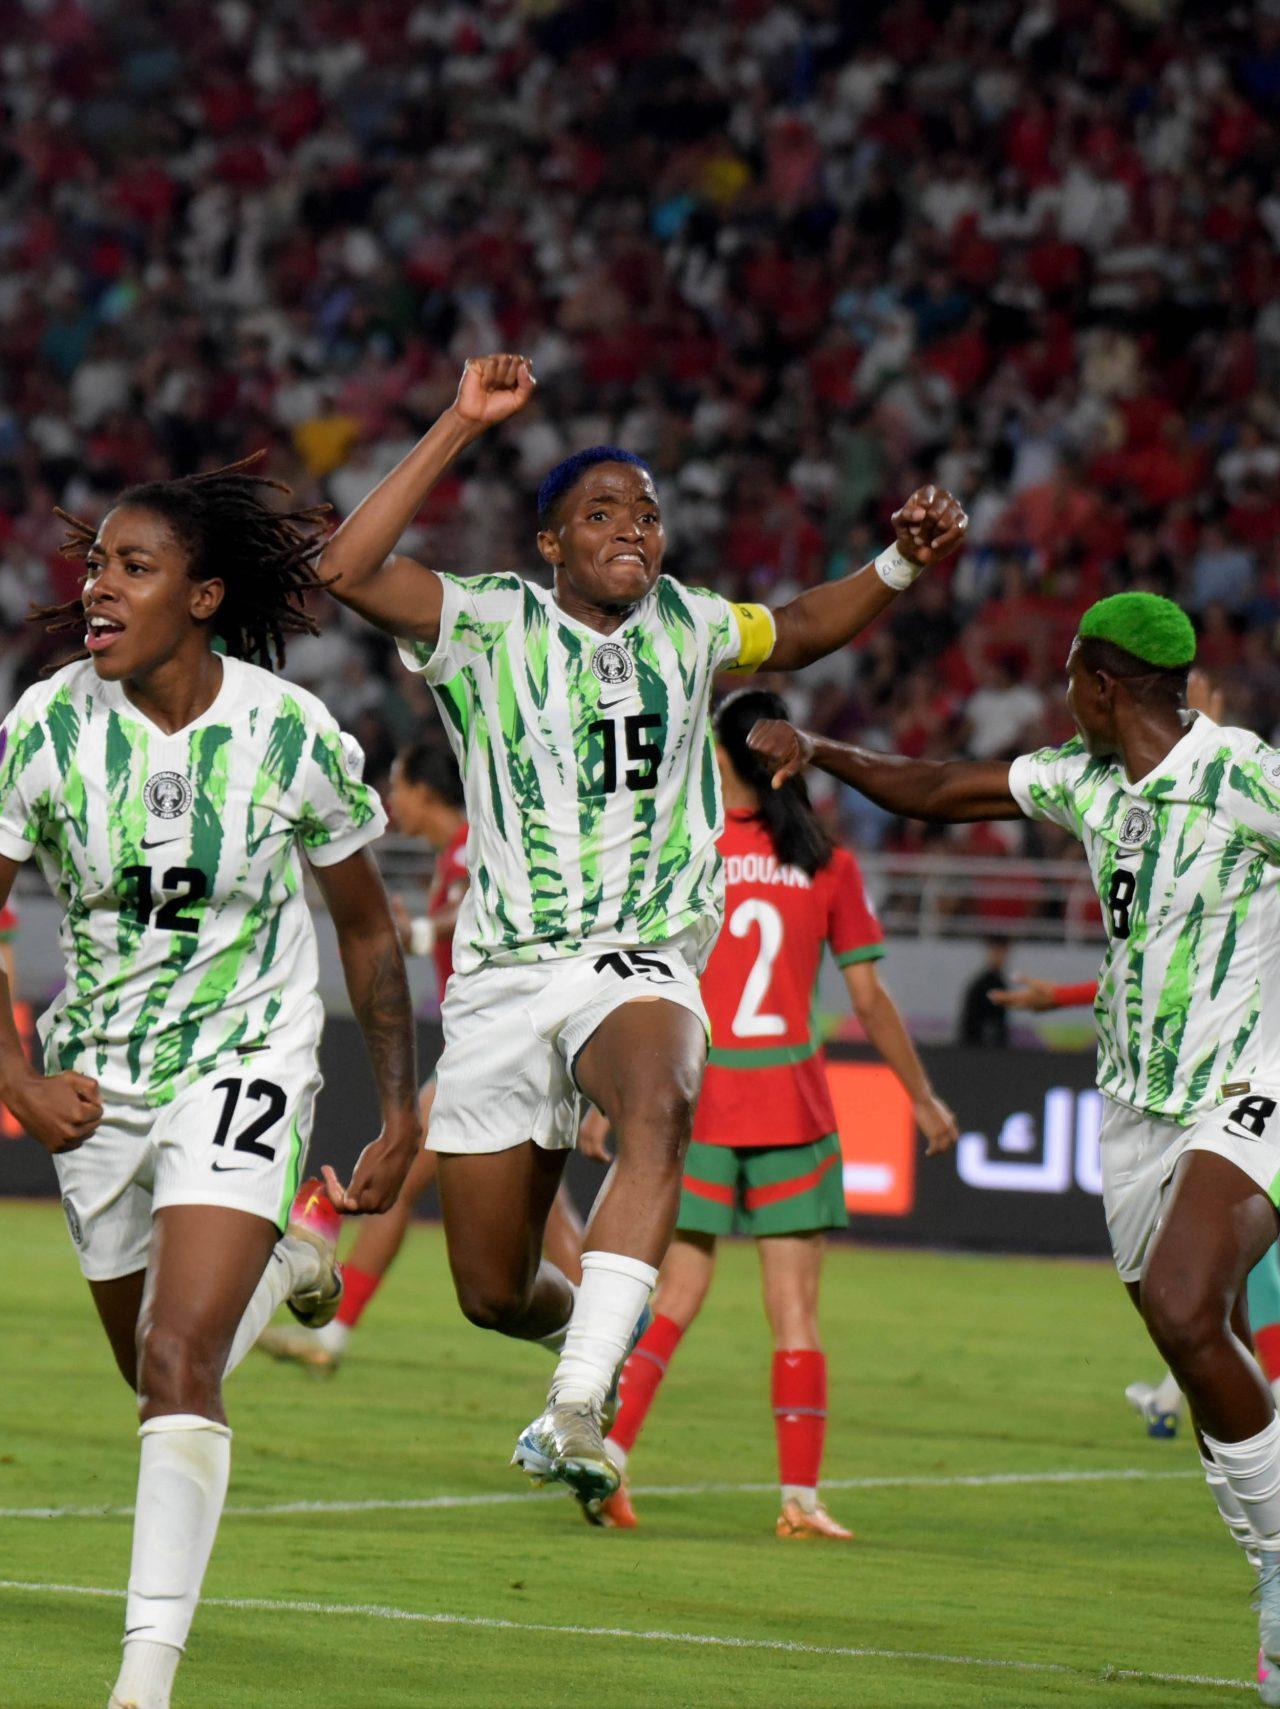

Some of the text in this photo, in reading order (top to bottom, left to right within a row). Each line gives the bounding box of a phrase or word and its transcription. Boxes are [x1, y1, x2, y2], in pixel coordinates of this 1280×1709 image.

[588, 714, 663, 793] 15
[122, 865, 207, 933] 12
[1109, 868, 1136, 940] 8
[729, 898, 787, 1038] 2
[212, 1077, 287, 1162] 12
[1228, 1095, 1277, 1137] 8
